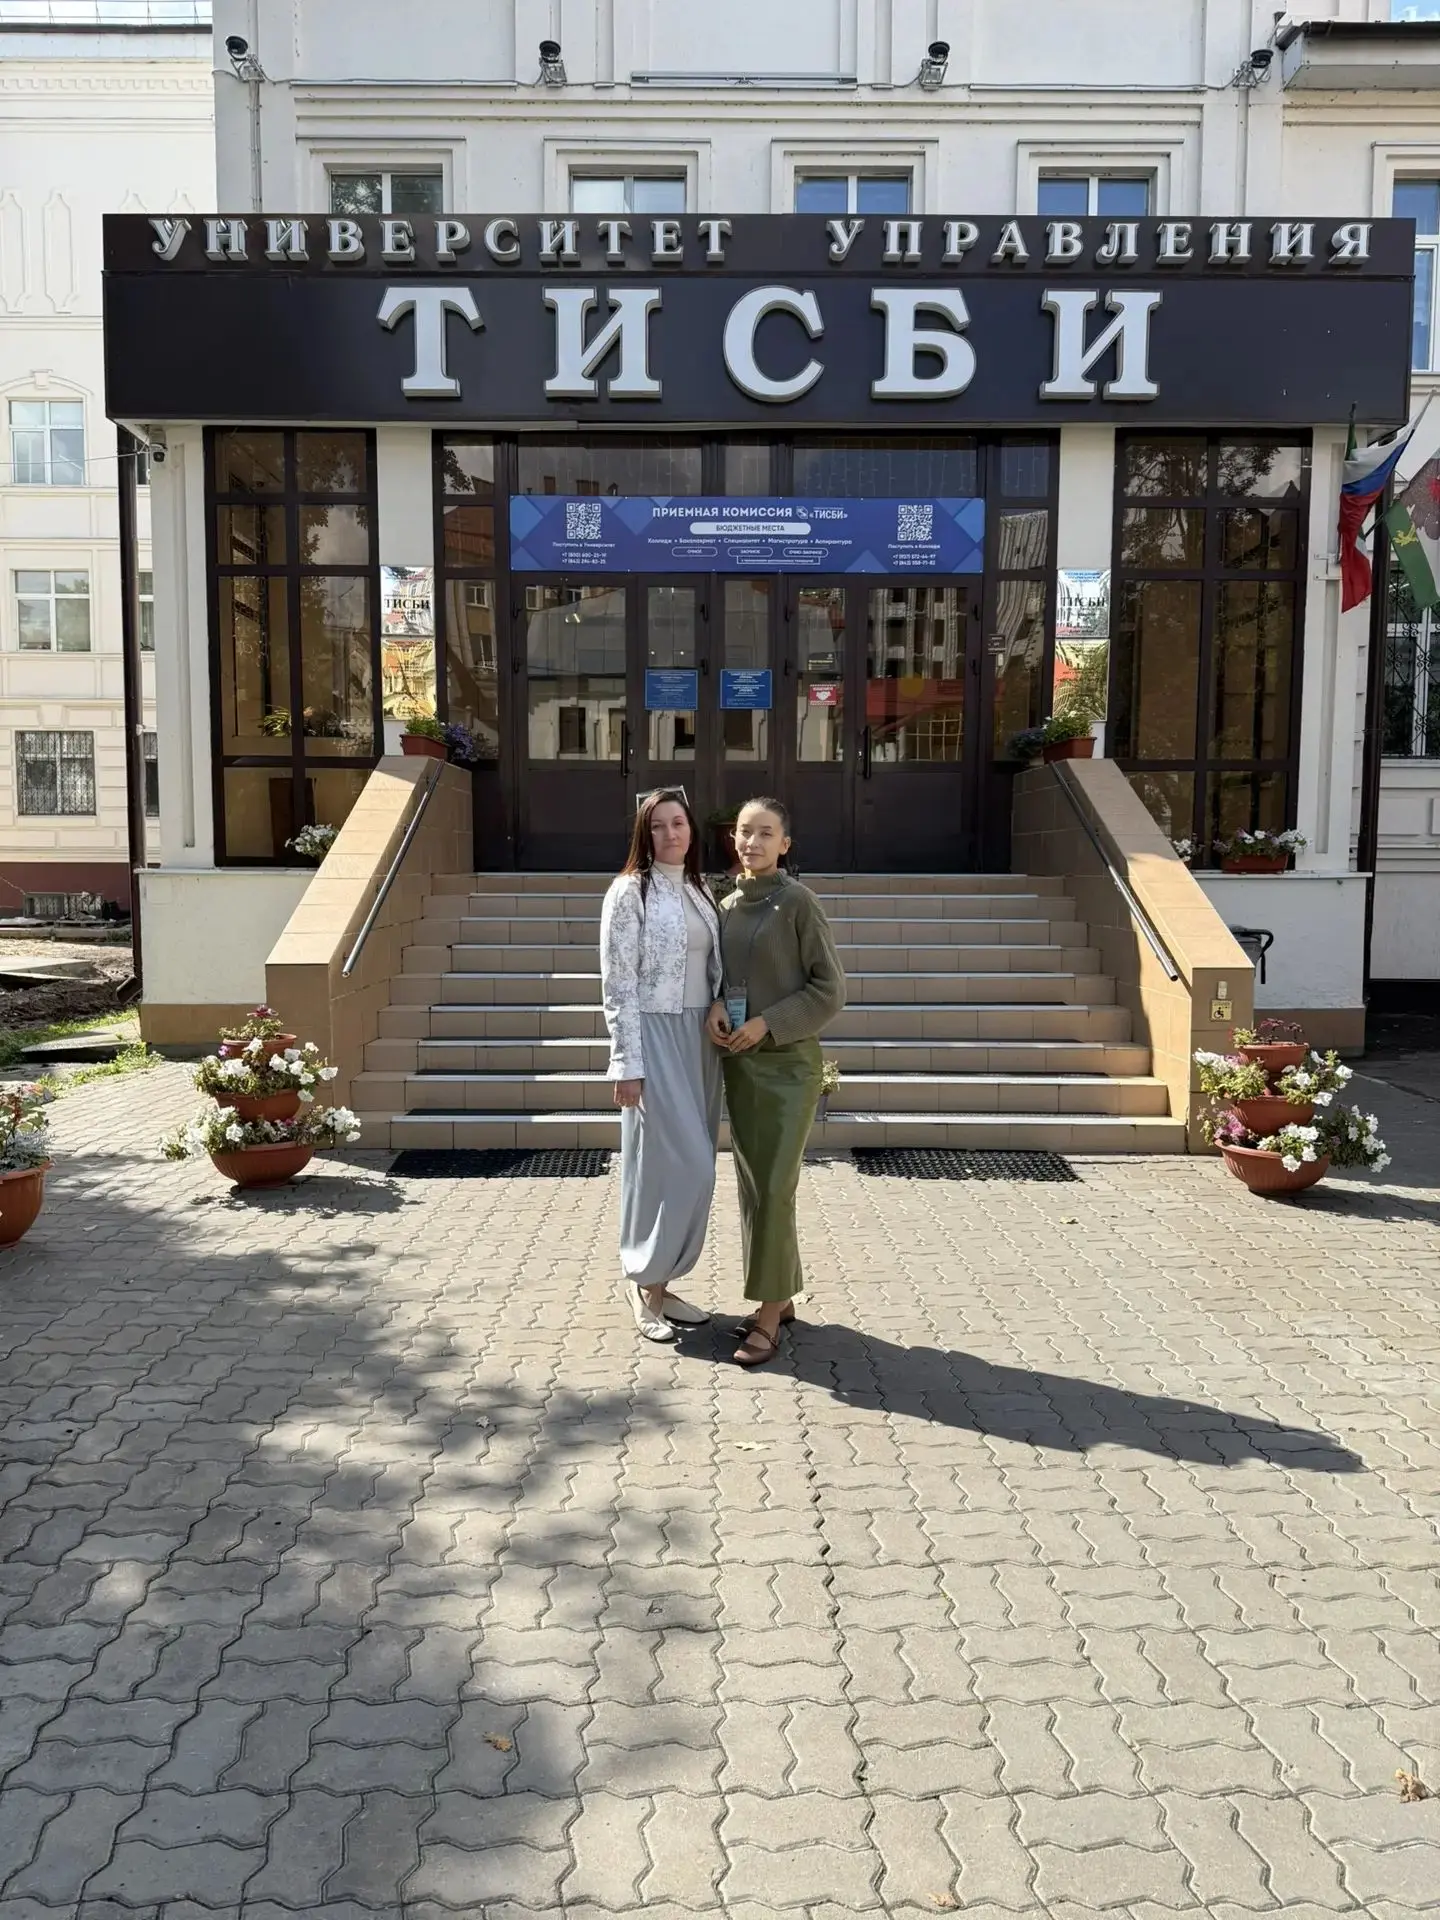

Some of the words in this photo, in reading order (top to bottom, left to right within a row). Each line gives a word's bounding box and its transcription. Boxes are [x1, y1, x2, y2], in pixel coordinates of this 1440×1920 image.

[148, 217, 734, 263] УНИВЕРСИТЕТ
[826, 219, 1374, 266] УПРАВЛЕНИЯ
[375, 284, 1163, 403] ТИСБИ
[652, 506, 719, 518] ПРИЕМНАЯ
[722, 507, 793, 518] КОМИССИЯ
[716, 524, 760, 532] БЮДЖЕТНЫЕ
[762, 524, 785, 532] МЕСТА
